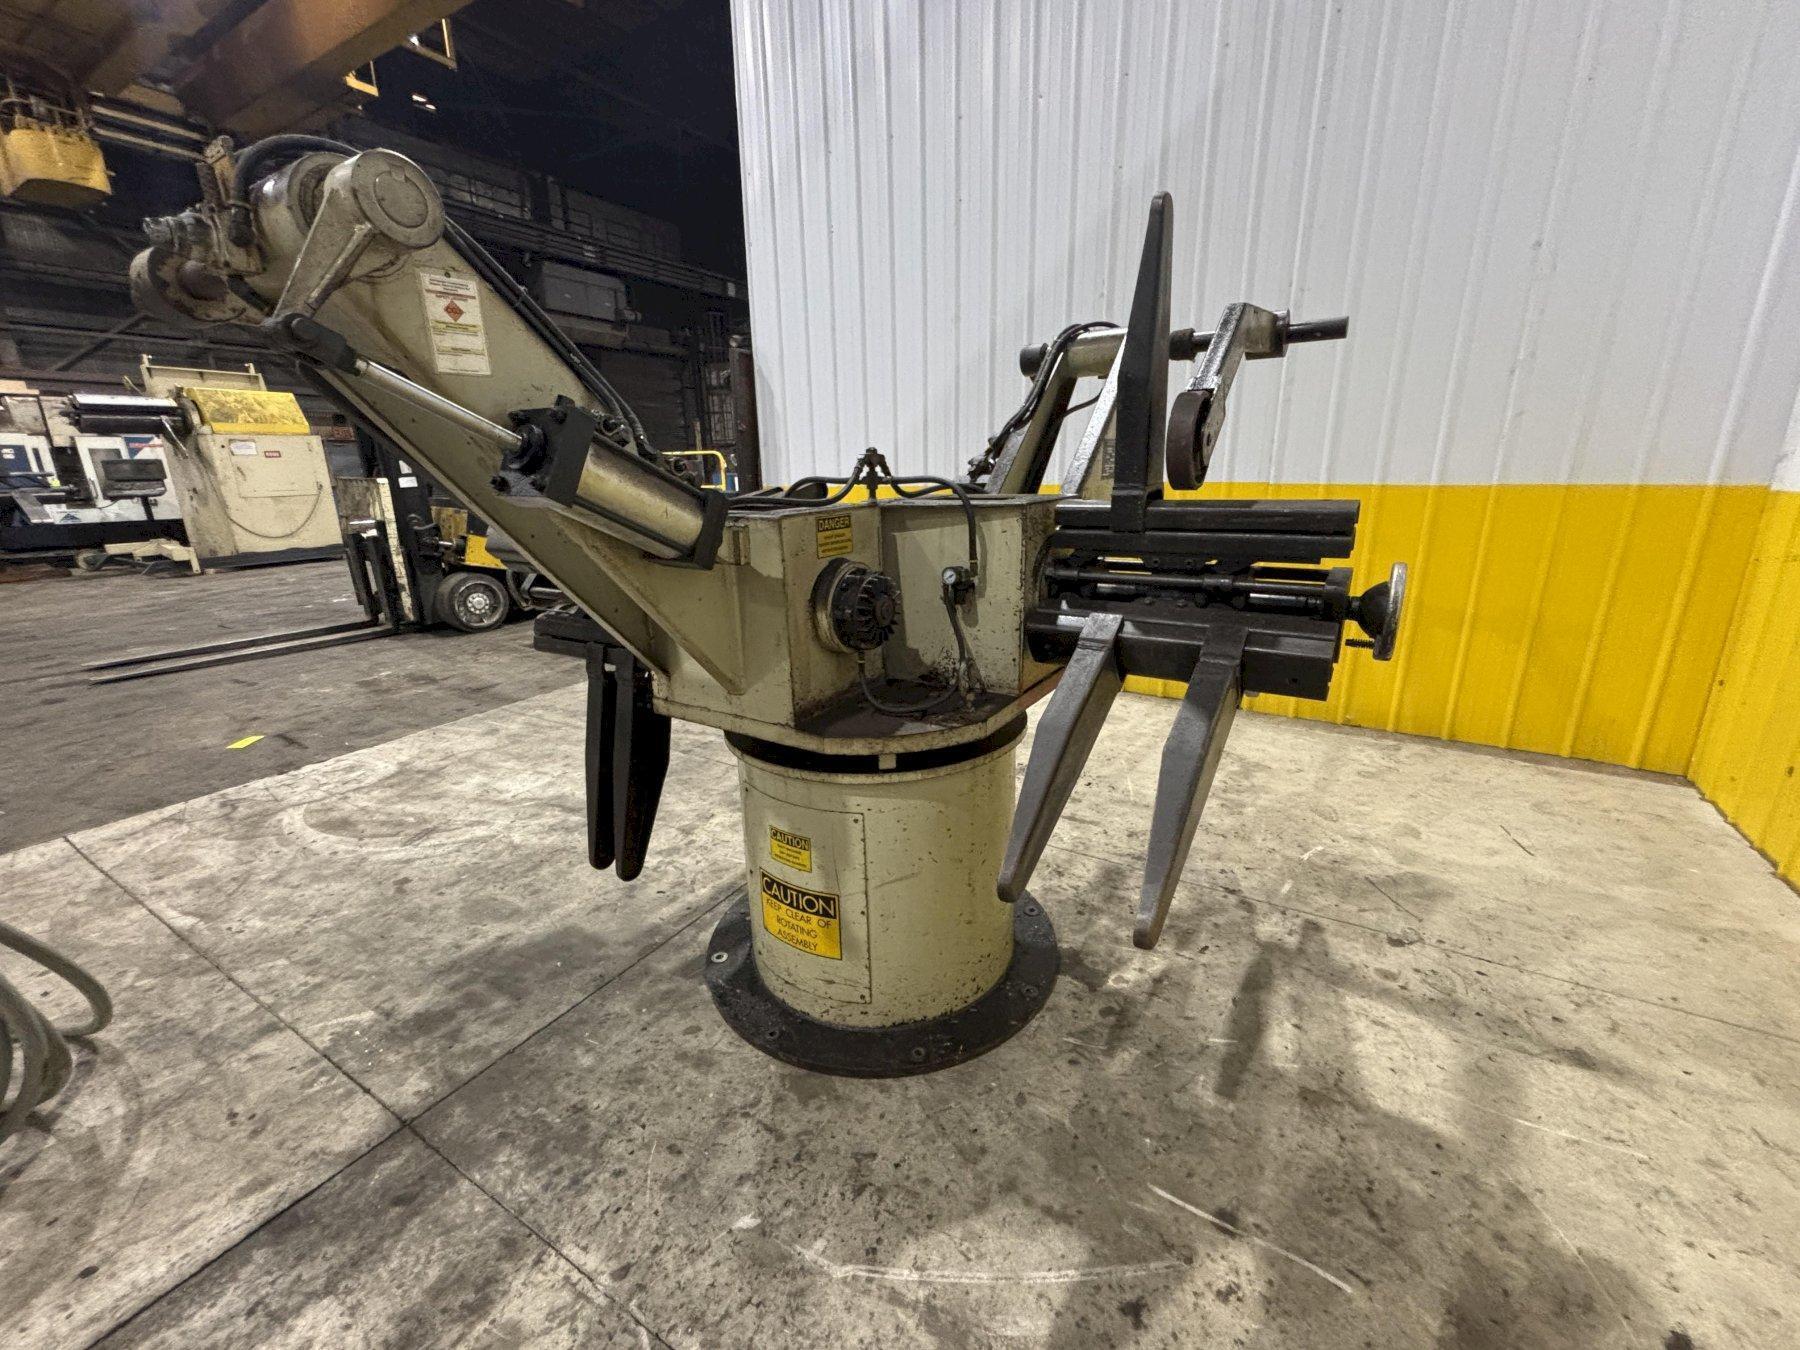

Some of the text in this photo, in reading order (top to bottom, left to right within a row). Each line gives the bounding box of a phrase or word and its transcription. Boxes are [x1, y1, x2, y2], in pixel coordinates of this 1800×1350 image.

[819, 516, 850, 531] DANGER
[771, 829, 809, 851] CAUTION
[763, 877, 835, 917] CAUTION
[766, 899, 832, 929] KEEP CLEAR OF
[776, 915, 818, 939] ROTATING
[777, 928, 818, 951] ASSEMBLY
